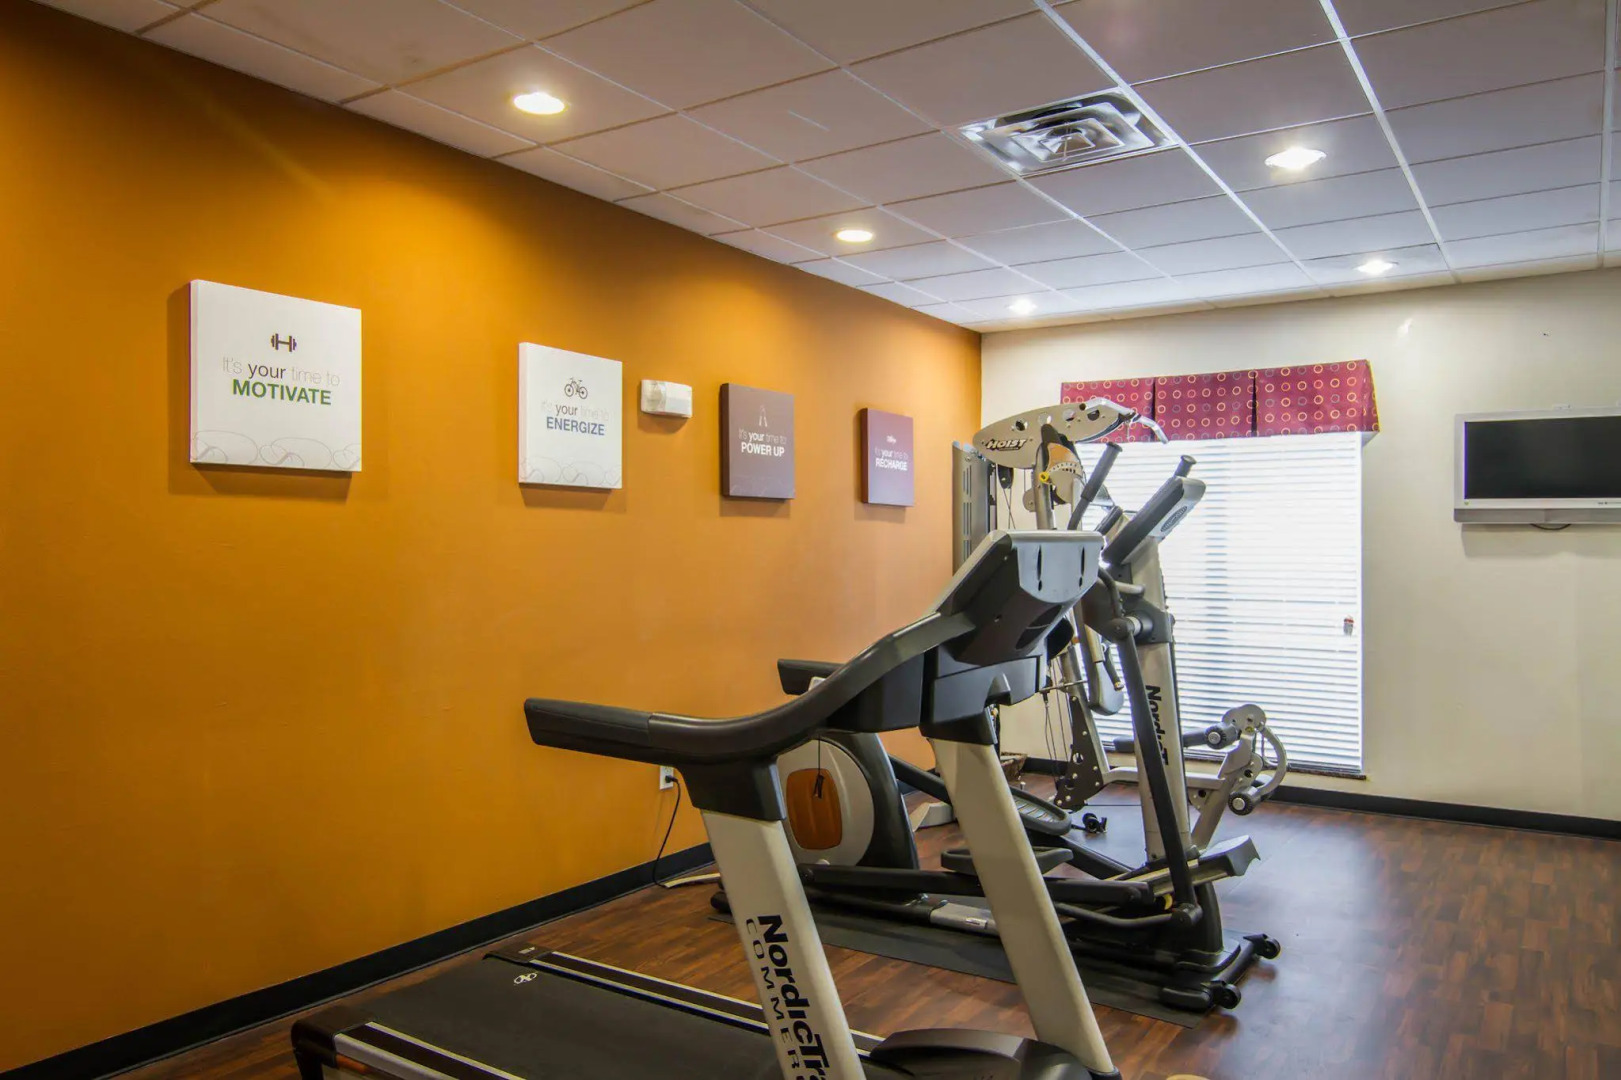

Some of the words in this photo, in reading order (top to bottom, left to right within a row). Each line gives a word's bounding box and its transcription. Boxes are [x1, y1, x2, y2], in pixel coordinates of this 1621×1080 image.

[222, 356, 242, 375] It's
[248, 363, 286, 379] your
[291, 366, 322, 385] time
[326, 371, 340, 387] to
[232, 378, 331, 405] MOTIVATE
[556, 404, 578, 417] your
[546, 416, 604, 435] ENERGIZE
[748, 431, 765, 443] your
[985, 438, 1027, 450] HOIST
[741, 442, 771, 455] POWER
[773, 446, 785, 457] UP
[746, 918, 805, 1080] COMMER
[758, 916, 829, 1080] NordicTr
